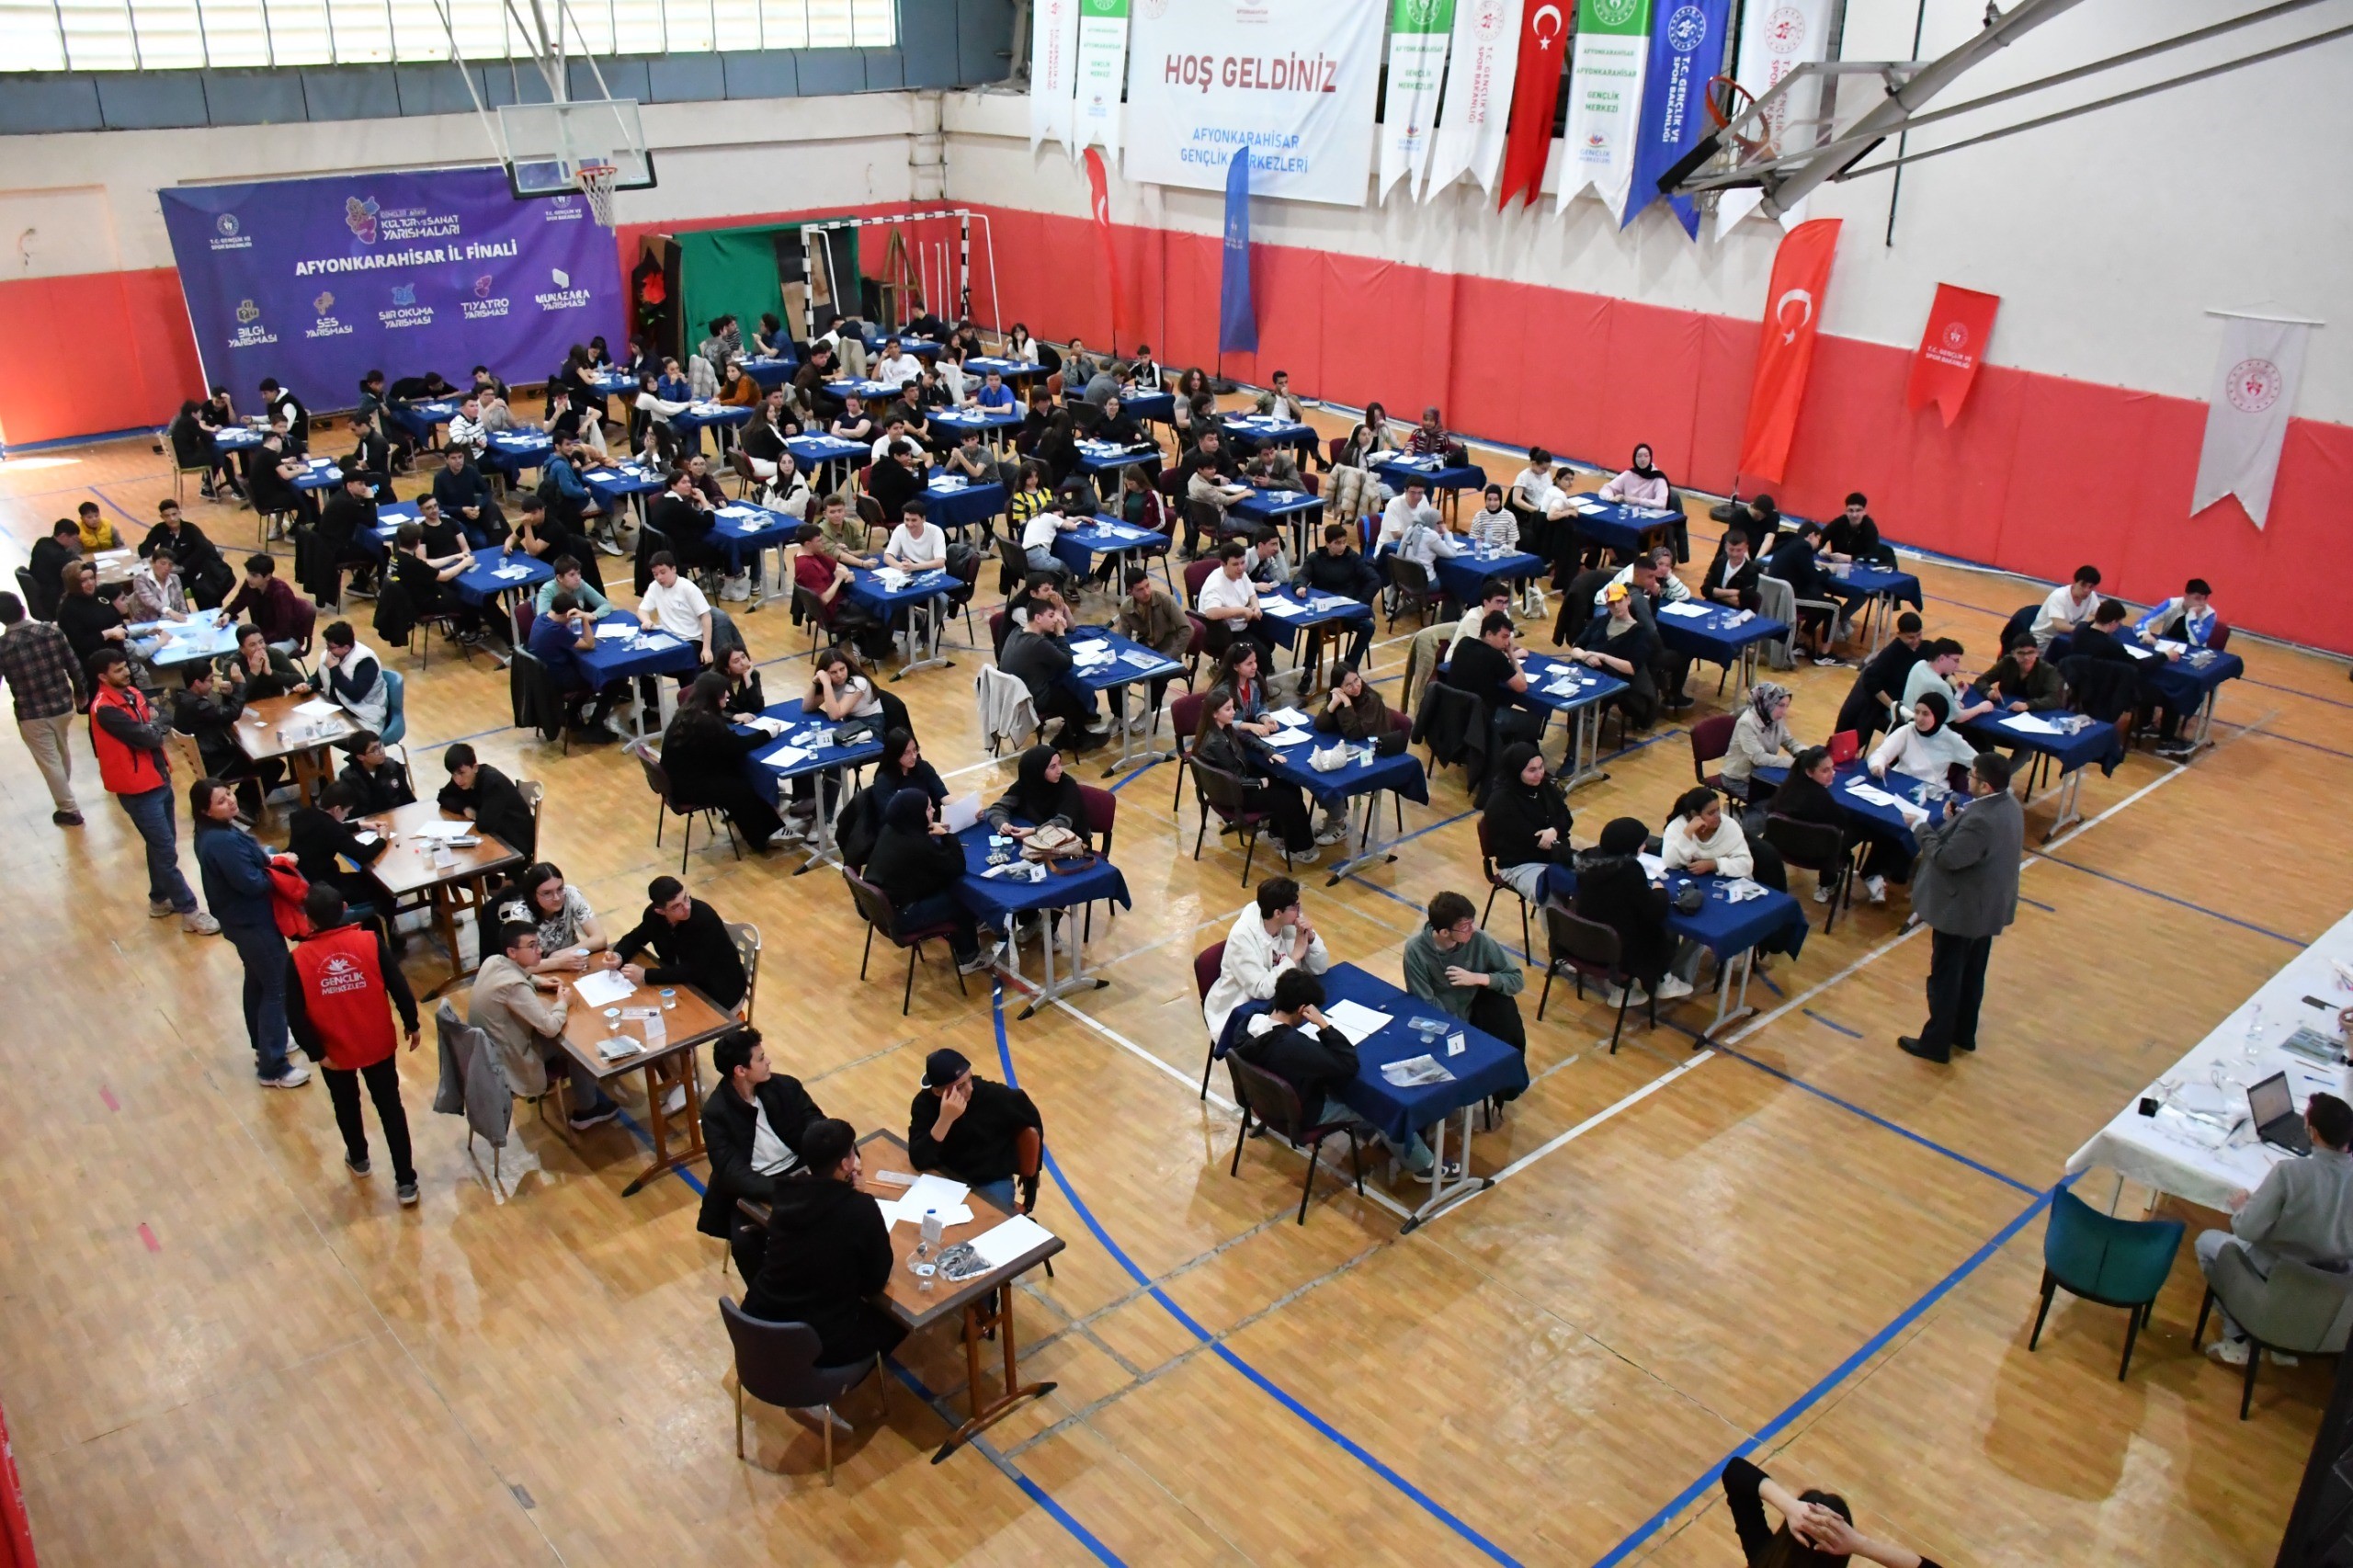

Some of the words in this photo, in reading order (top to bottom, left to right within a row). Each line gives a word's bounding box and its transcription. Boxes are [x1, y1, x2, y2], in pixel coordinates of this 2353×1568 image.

[1165, 54, 1214, 94] HOŞ
[1222, 51, 1337, 93] GELDİNİZ
[1670, 56, 1681, 85] SPOR
[1193, 128, 1300, 150] AFYONKARAHİSAR
[1669, 130, 1681, 143] VE
[1180, 148, 1229, 168] GENÇLİK
[1233, 152, 1309, 174] RKEZLERİ
[426, 214, 460, 226] SANAT
[295, 247, 447, 277] AFYONKARAHİSAR
[448, 244, 464, 262] İL
[466, 239, 518, 259] FİNALİ
[316, 317, 340, 329] SES
[397, 306, 435, 318] OKUMA
